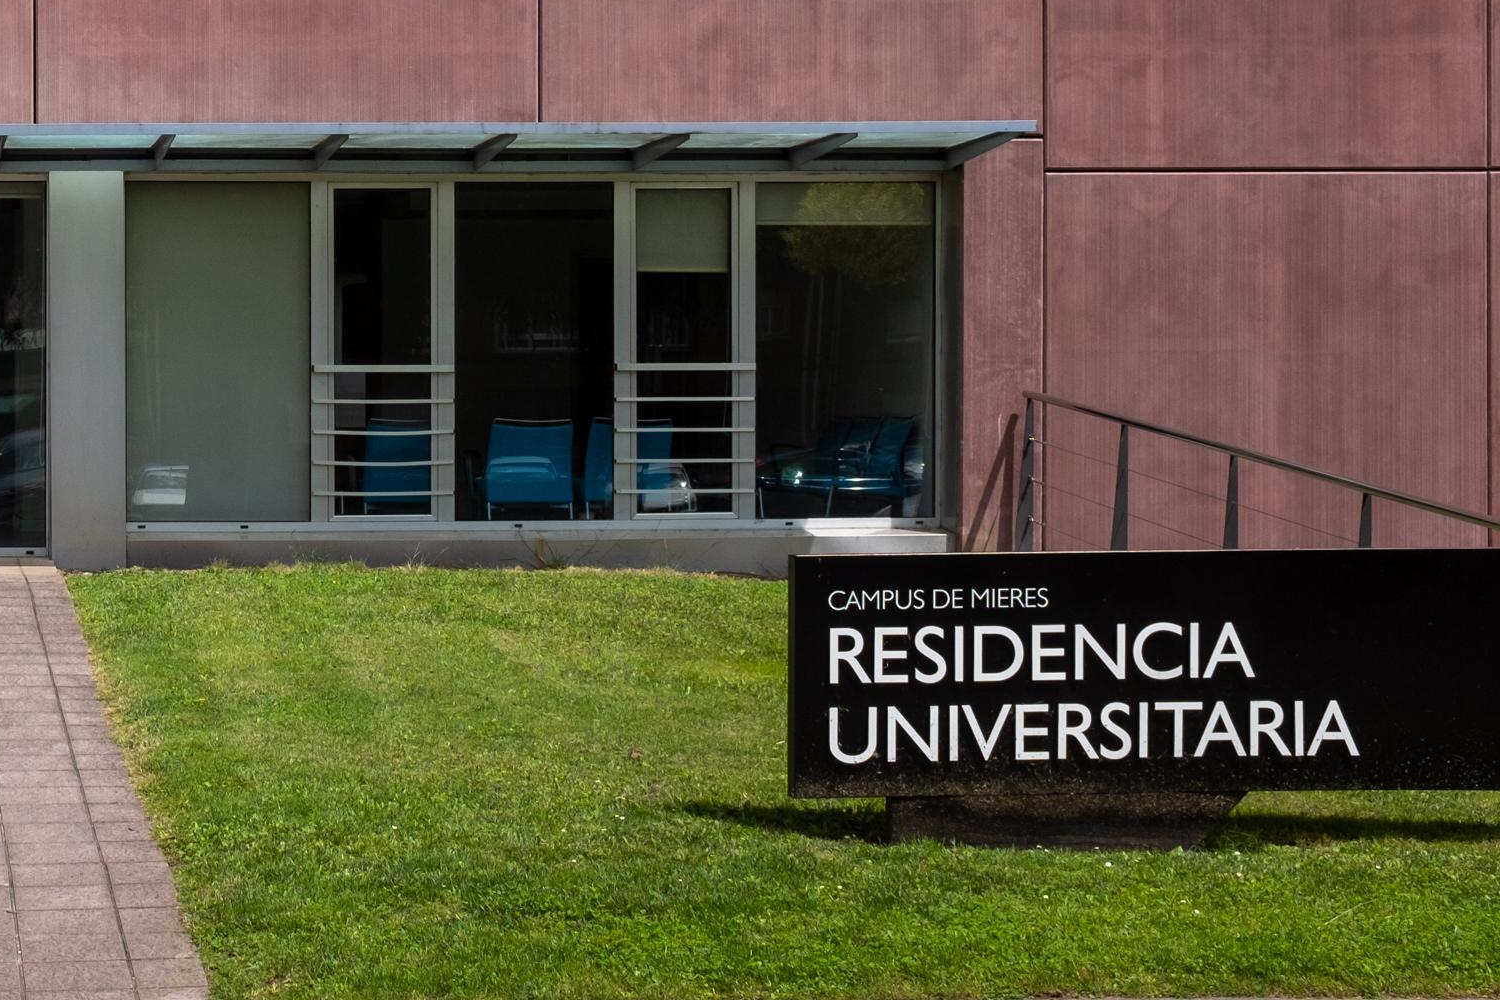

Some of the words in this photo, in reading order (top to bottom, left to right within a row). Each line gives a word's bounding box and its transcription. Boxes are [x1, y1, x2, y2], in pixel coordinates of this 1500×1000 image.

[827, 588, 926, 612] CAMPUS
[932, 588, 965, 610] DE
[971, 587, 1050, 610] MIERES
[828, 621, 1257, 685] RESIDENCIA
[828, 700, 1361, 764] UNIVERSITARIA
